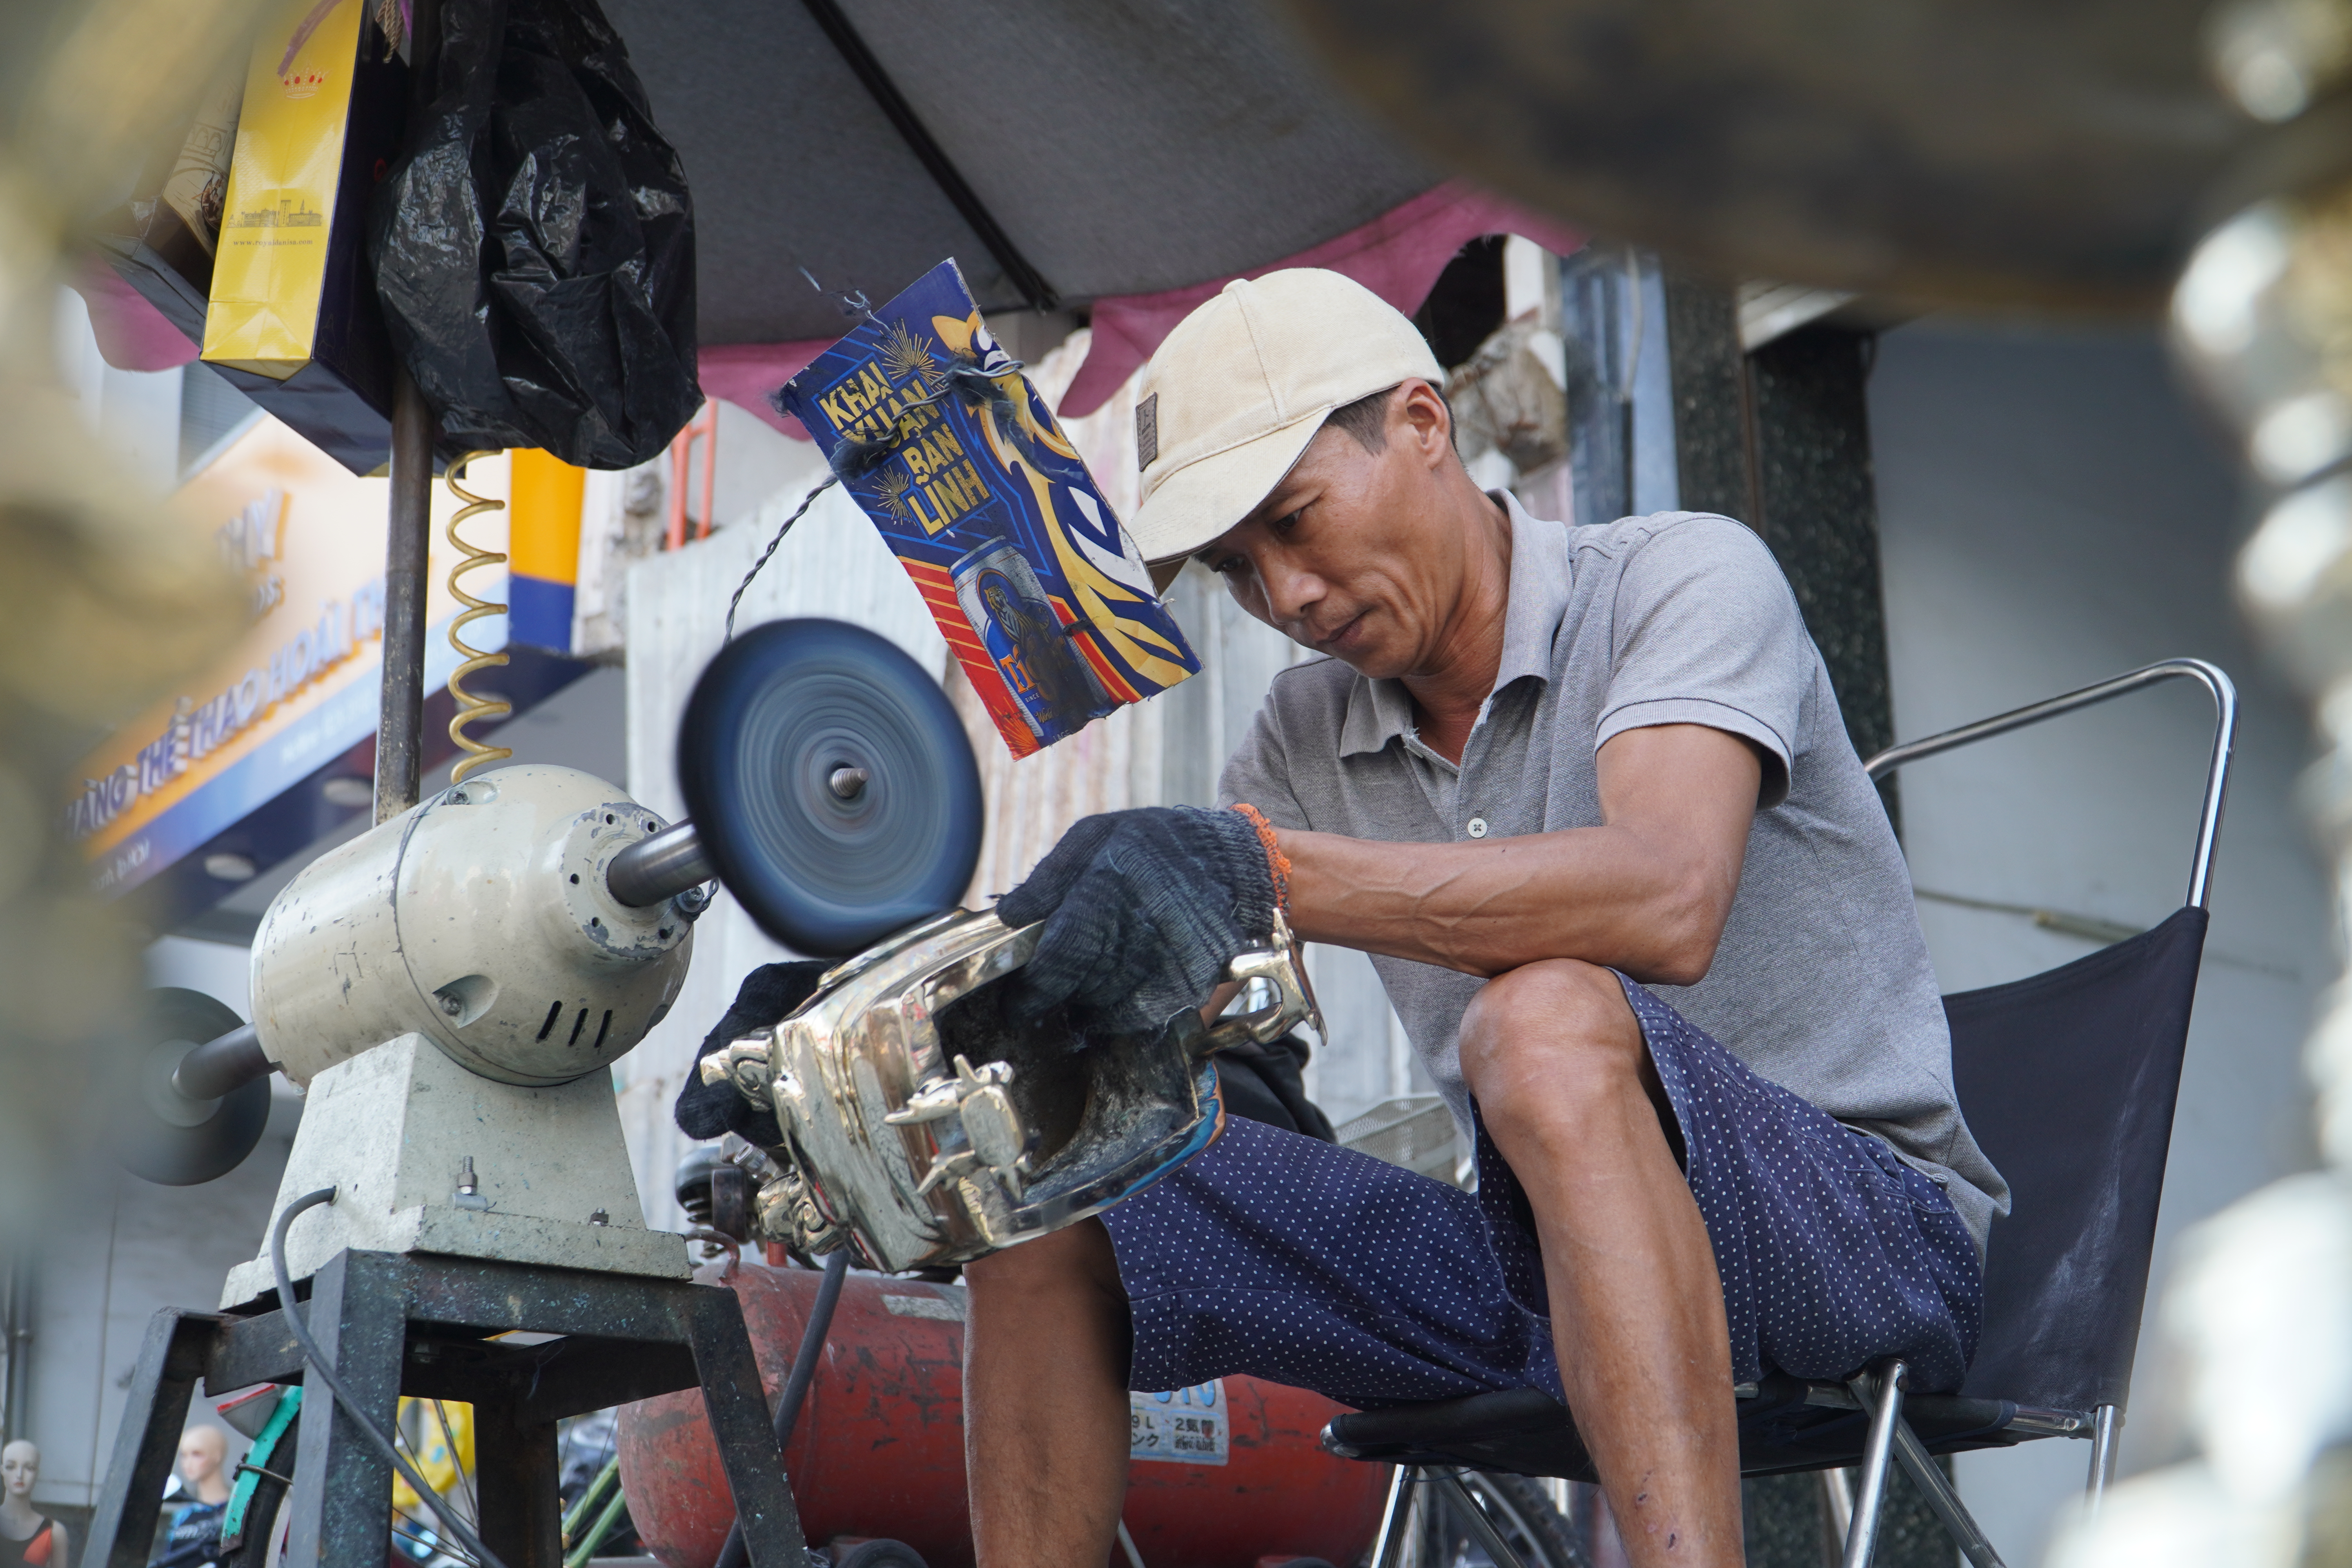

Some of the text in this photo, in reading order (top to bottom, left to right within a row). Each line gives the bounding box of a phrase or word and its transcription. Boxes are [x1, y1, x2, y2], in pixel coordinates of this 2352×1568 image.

[233, 238, 313, 247] www.royaldanisa.com
[819, 361, 891, 430] KHAI
[907, 459, 990, 535] LĨNH
[999, 634, 1076, 702] Tigr
[1025, 692, 1040, 703] SINCE
